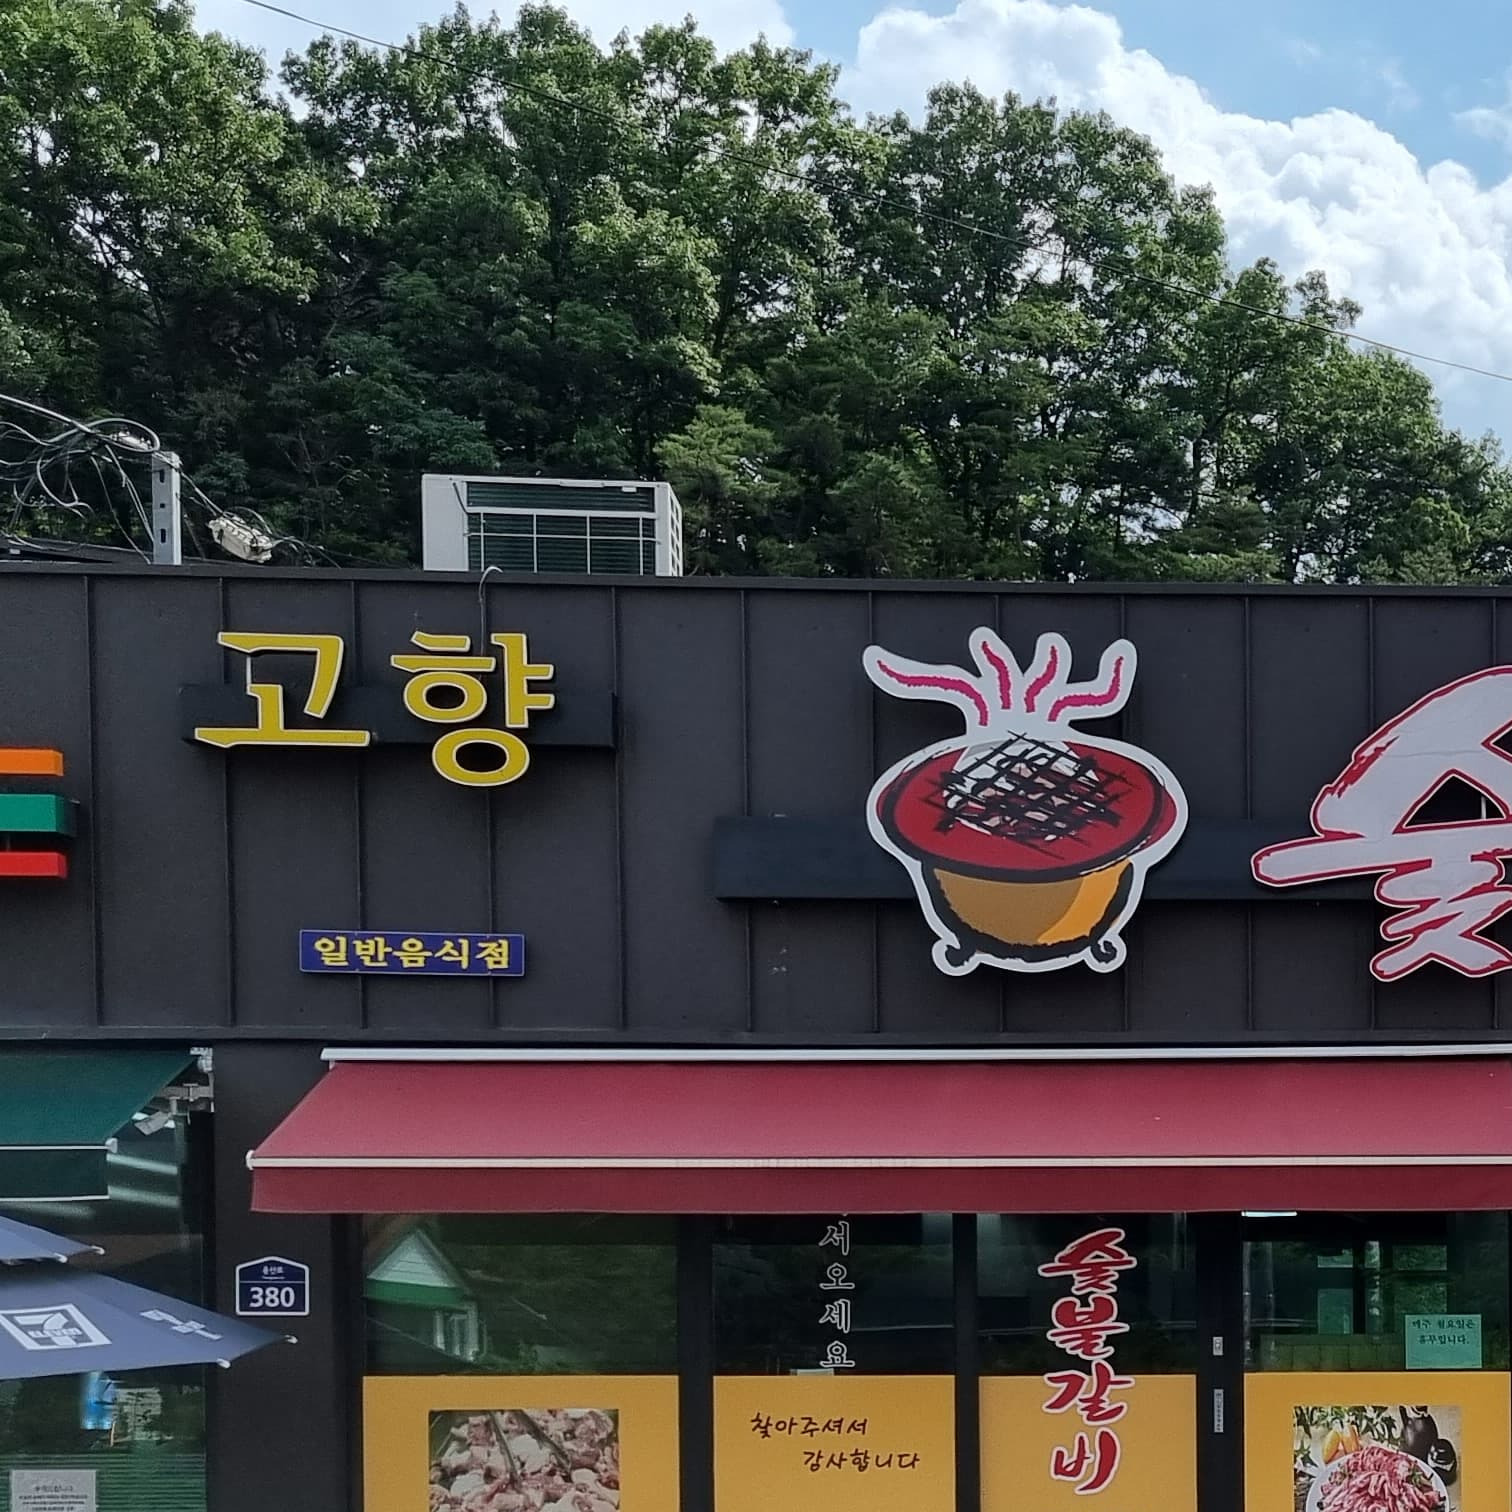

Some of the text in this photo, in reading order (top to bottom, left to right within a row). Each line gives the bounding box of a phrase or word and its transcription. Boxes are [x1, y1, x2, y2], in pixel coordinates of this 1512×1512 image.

[194, 631, 555, 787] 고향
[313, 936, 512, 970] 일반음식점
[249, 1286, 295, 1308] 380
[818, 1212, 856, 1368] 서오세요
[1038, 1227, 1137, 1495] 숯불갈비
[803, 1448, 920, 1473] 감사합니다
